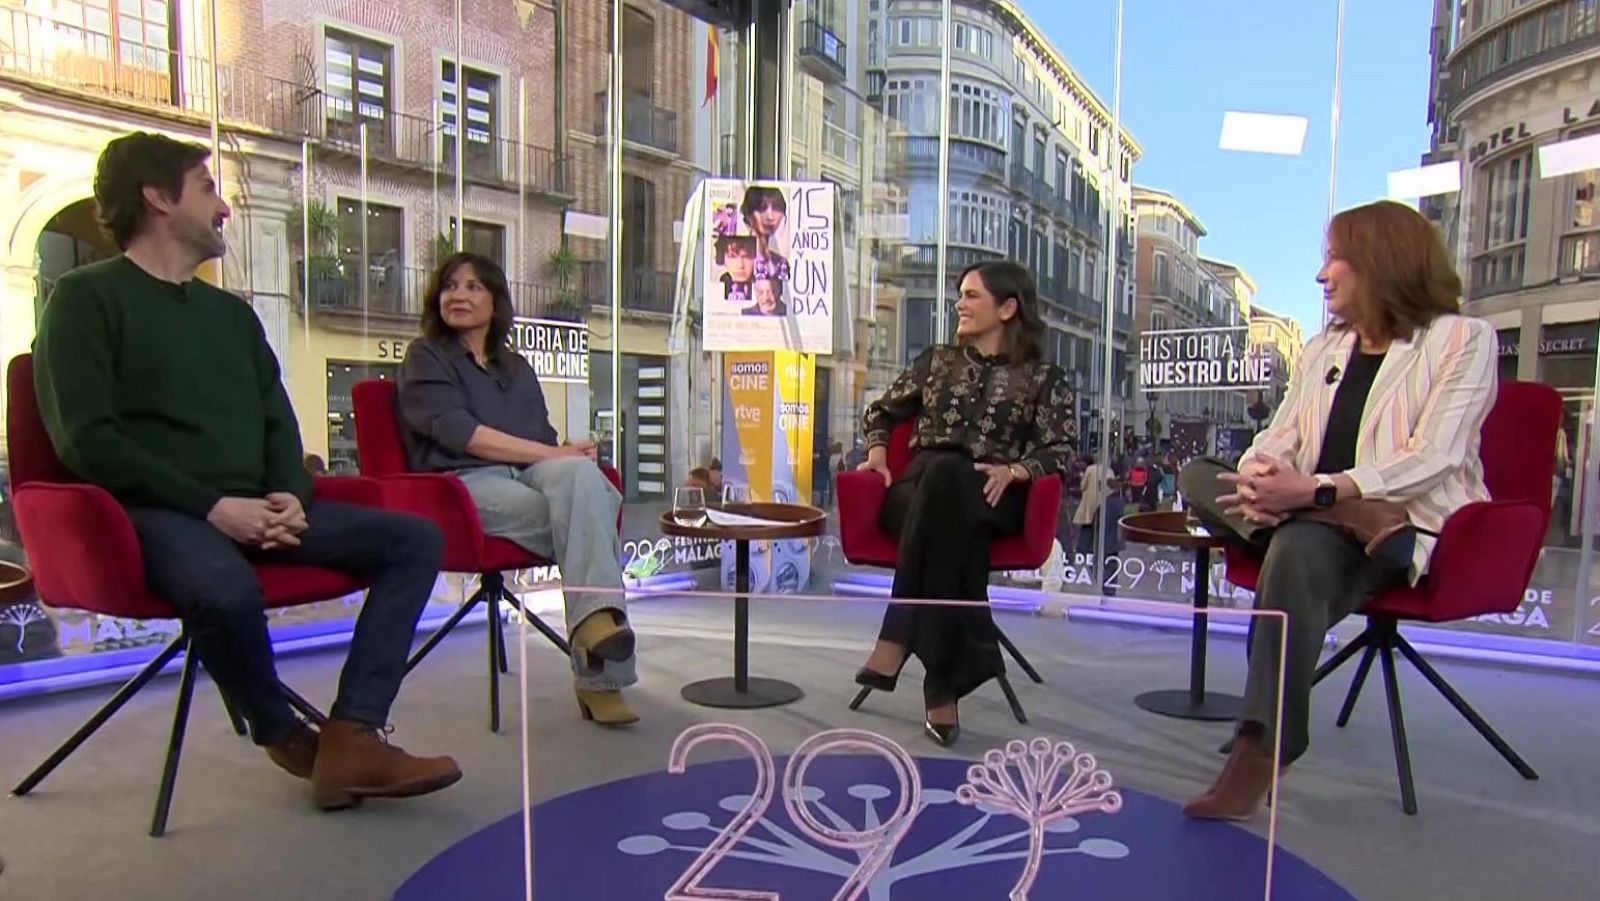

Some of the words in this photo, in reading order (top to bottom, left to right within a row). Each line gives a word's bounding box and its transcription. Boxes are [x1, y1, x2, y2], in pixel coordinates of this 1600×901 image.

[1469, 122, 1531, 163] HOTEL
[792, 187, 829, 229] 15
[796, 251, 804, 260] Y
[793, 258, 827, 296] UN
[568, 329, 588, 353] DE
[1140, 333, 1234, 361] HISTORIA
[1539, 339, 1586, 353] SECRET
[556, 351, 588, 377] CINE
[731, 362, 768, 373] somos
[1140, 360, 1222, 385] NUESTRO
[1227, 358, 1272, 383] CINE
[730, 374, 769, 391] CINE
[735, 404, 761, 422] rtve
[1075, 553, 1094, 566] DE
[1104, 556, 1144, 590] 29
[1524, 589, 1553, 604] DE
[664, 722, 922, 901] 29
